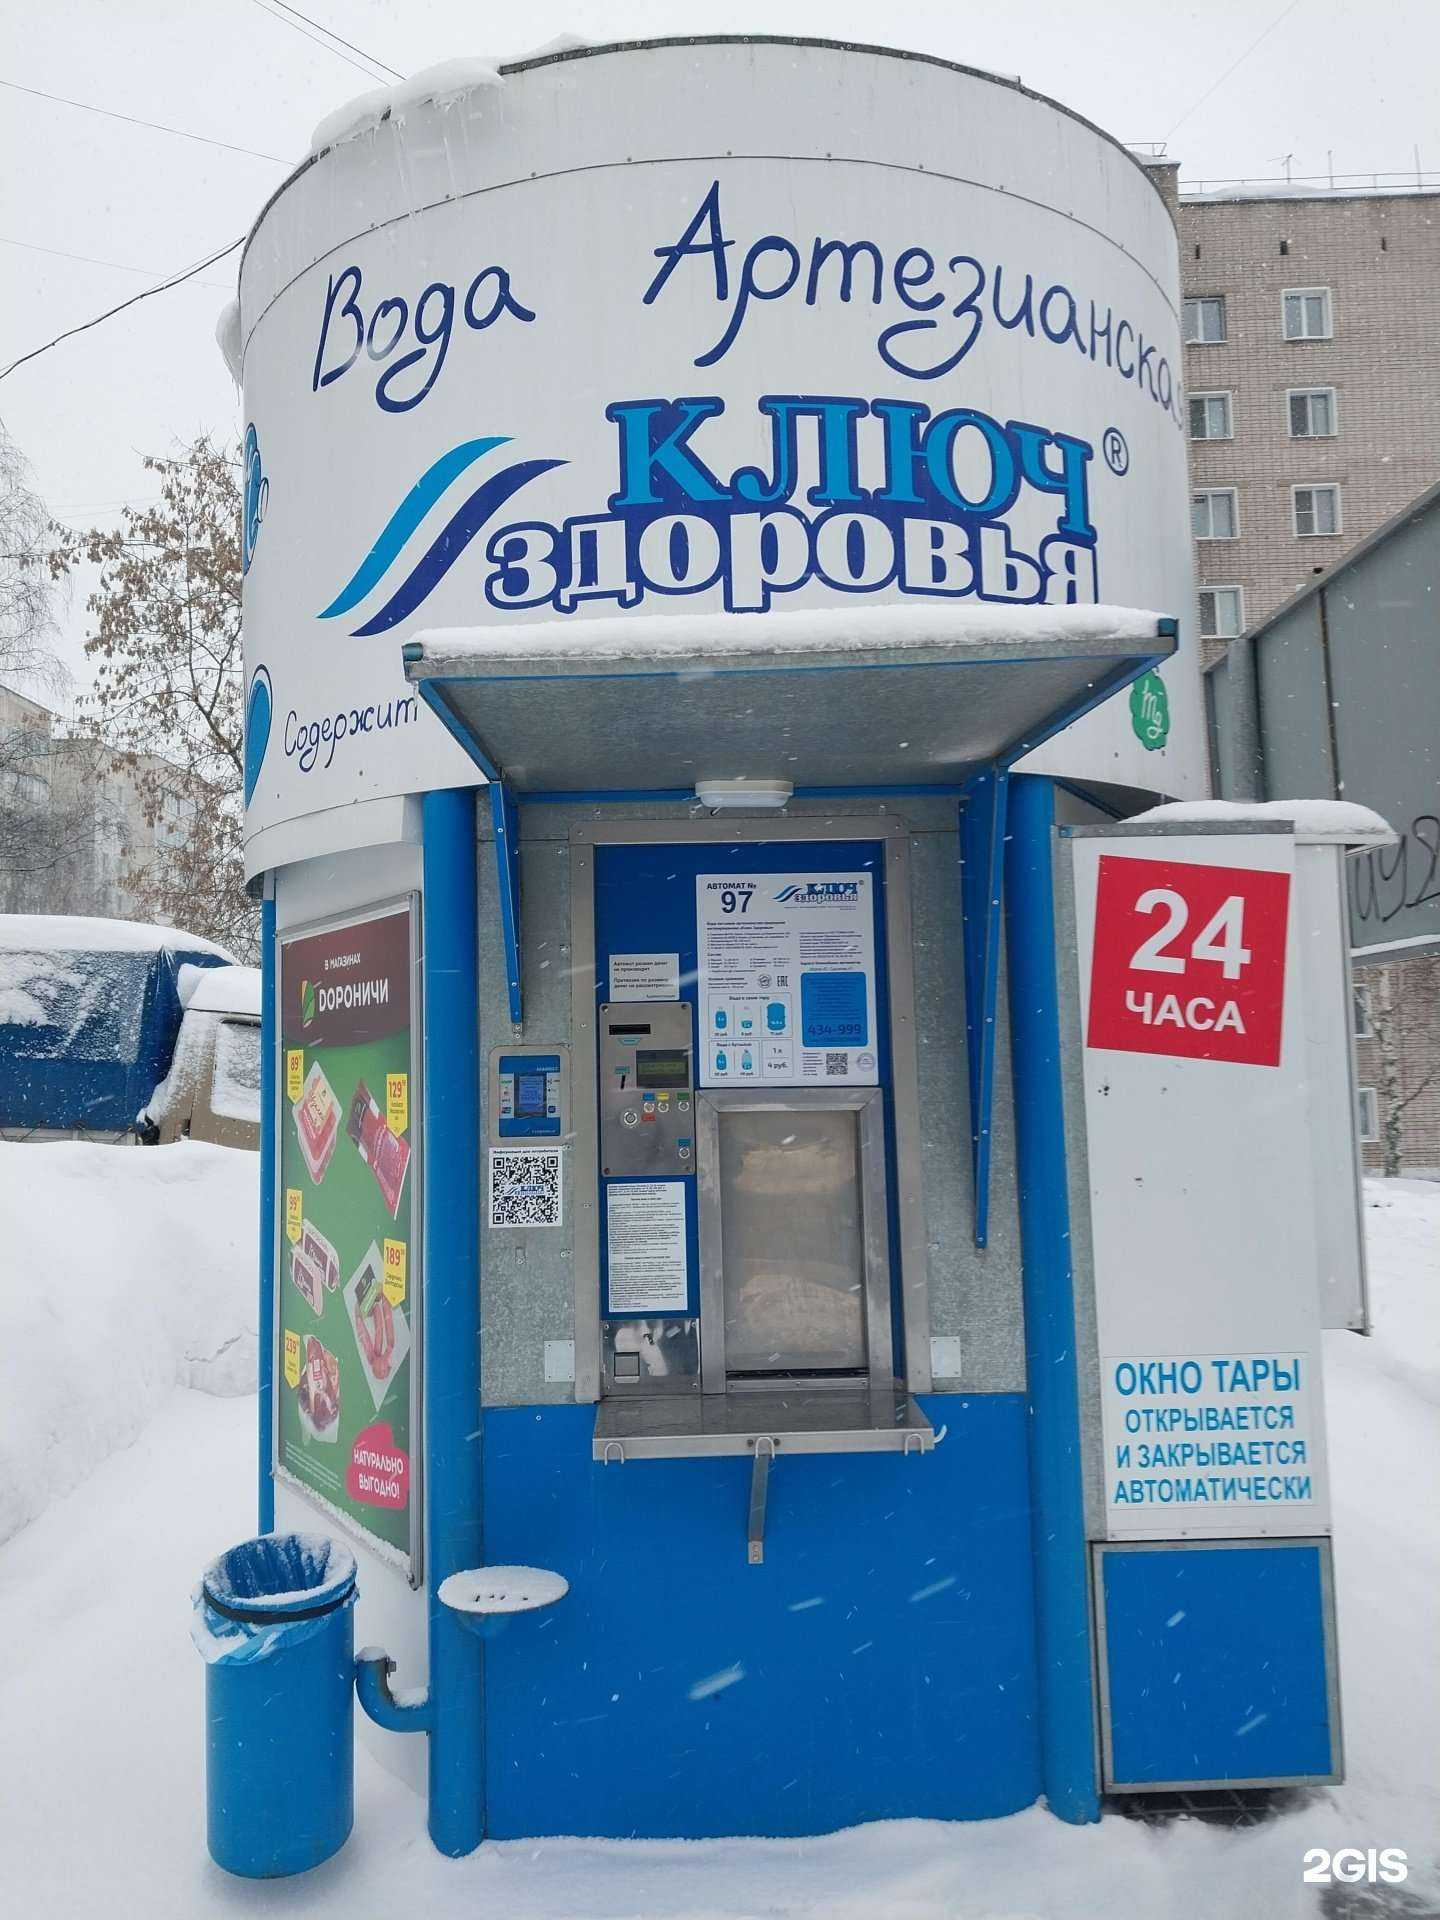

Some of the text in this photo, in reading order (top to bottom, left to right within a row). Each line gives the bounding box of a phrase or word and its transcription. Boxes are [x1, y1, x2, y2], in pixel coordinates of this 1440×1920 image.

[313, 265, 536, 413] Вода
[606, 394, 1097, 544] КЛЮЧ
[485, 504, 1098, 614] здоровья
[285, 697, 418, 772] Содержит
[706, 882, 746, 890] АВТОМАТ
[721, 890, 753, 914] 97
[1128, 888, 1252, 980] 24
[330, 952, 361, 969] МАГАЗИНАХ
[1125, 990, 1247, 1035] ЧАСА
[807, 1023, 862, 1036] 434-999
[1115, 1358, 1300, 1396] ОКНО ТАРЫ
[1125, 1405, 1295, 1433] ОТКРЫВАЕТСЯ
[353, 1447, 404, 1475] НАТУРАЛЬНО
[1116, 1440, 1307, 1469] И ЗАКРЫВАЕТСЯ
[358, 1473, 400, 1500] ВЫГОДНО!
[1114, 1475, 1313, 1504] АВТОМАТИЧЕСКИ
